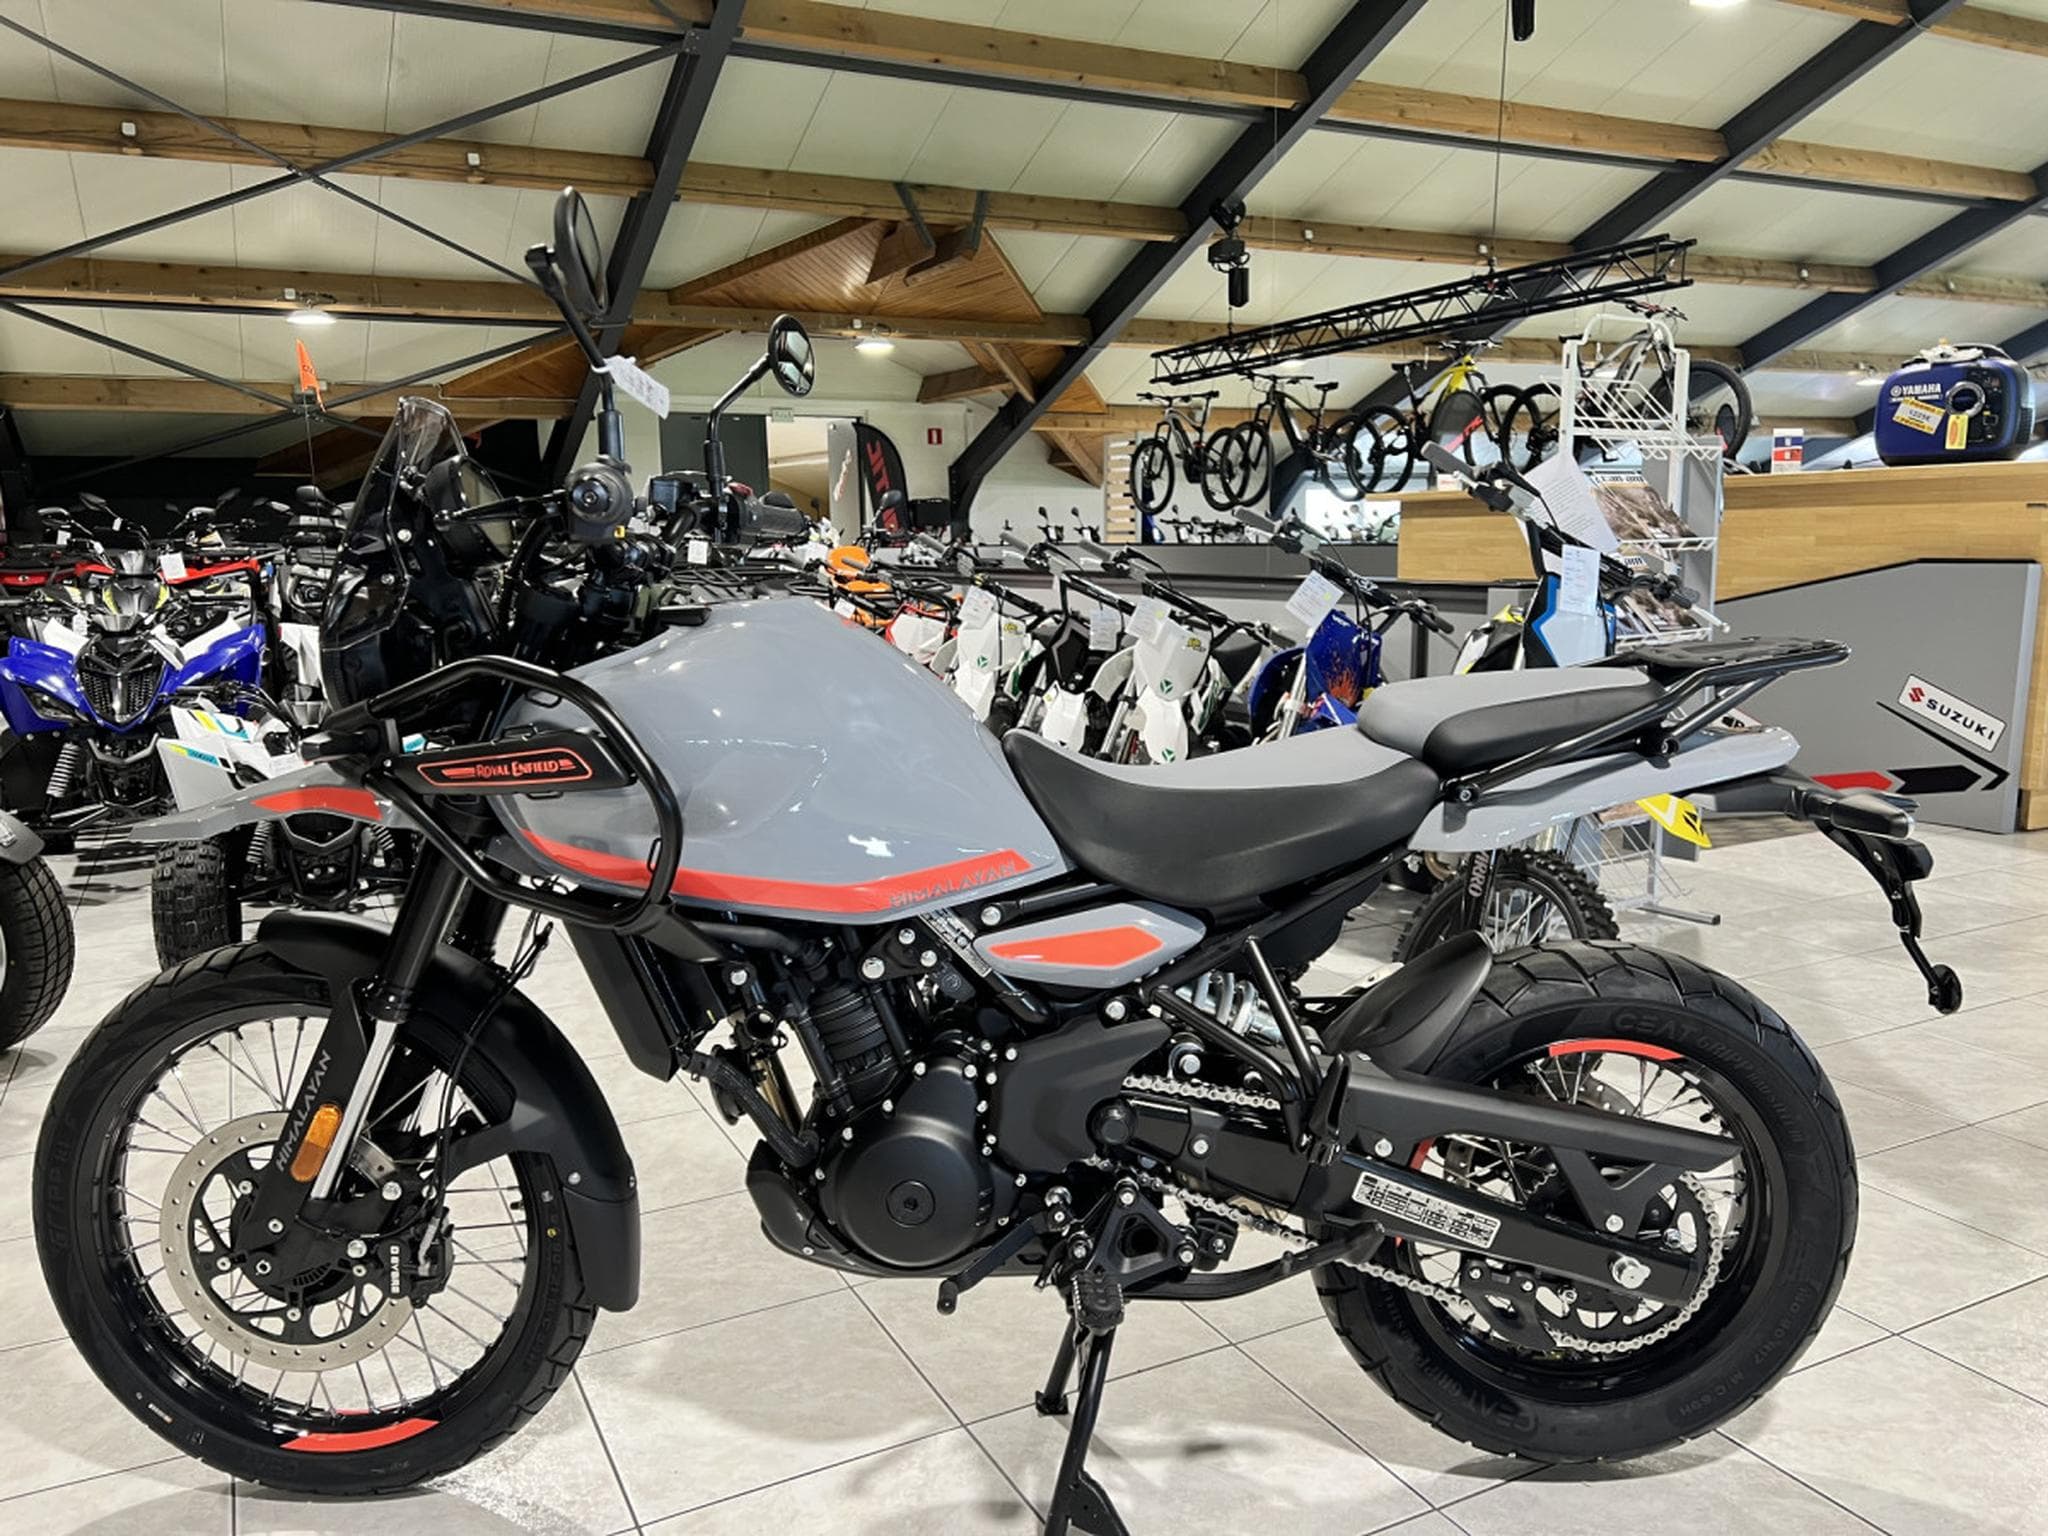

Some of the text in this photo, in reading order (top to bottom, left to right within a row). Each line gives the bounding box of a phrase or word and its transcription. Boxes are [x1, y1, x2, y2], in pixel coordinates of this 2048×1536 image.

[1902, 383, 1942, 395] YAMAHA
[1926, 698, 1995, 740] SUZUKI
[476, 759, 559, 779] ROYAL ENFIELD
[889, 857, 1017, 907] HIMALAYAN
[1612, 1011, 1700, 1043] CEAT
[275, 1049, 332, 1171] HIMALAYAN
